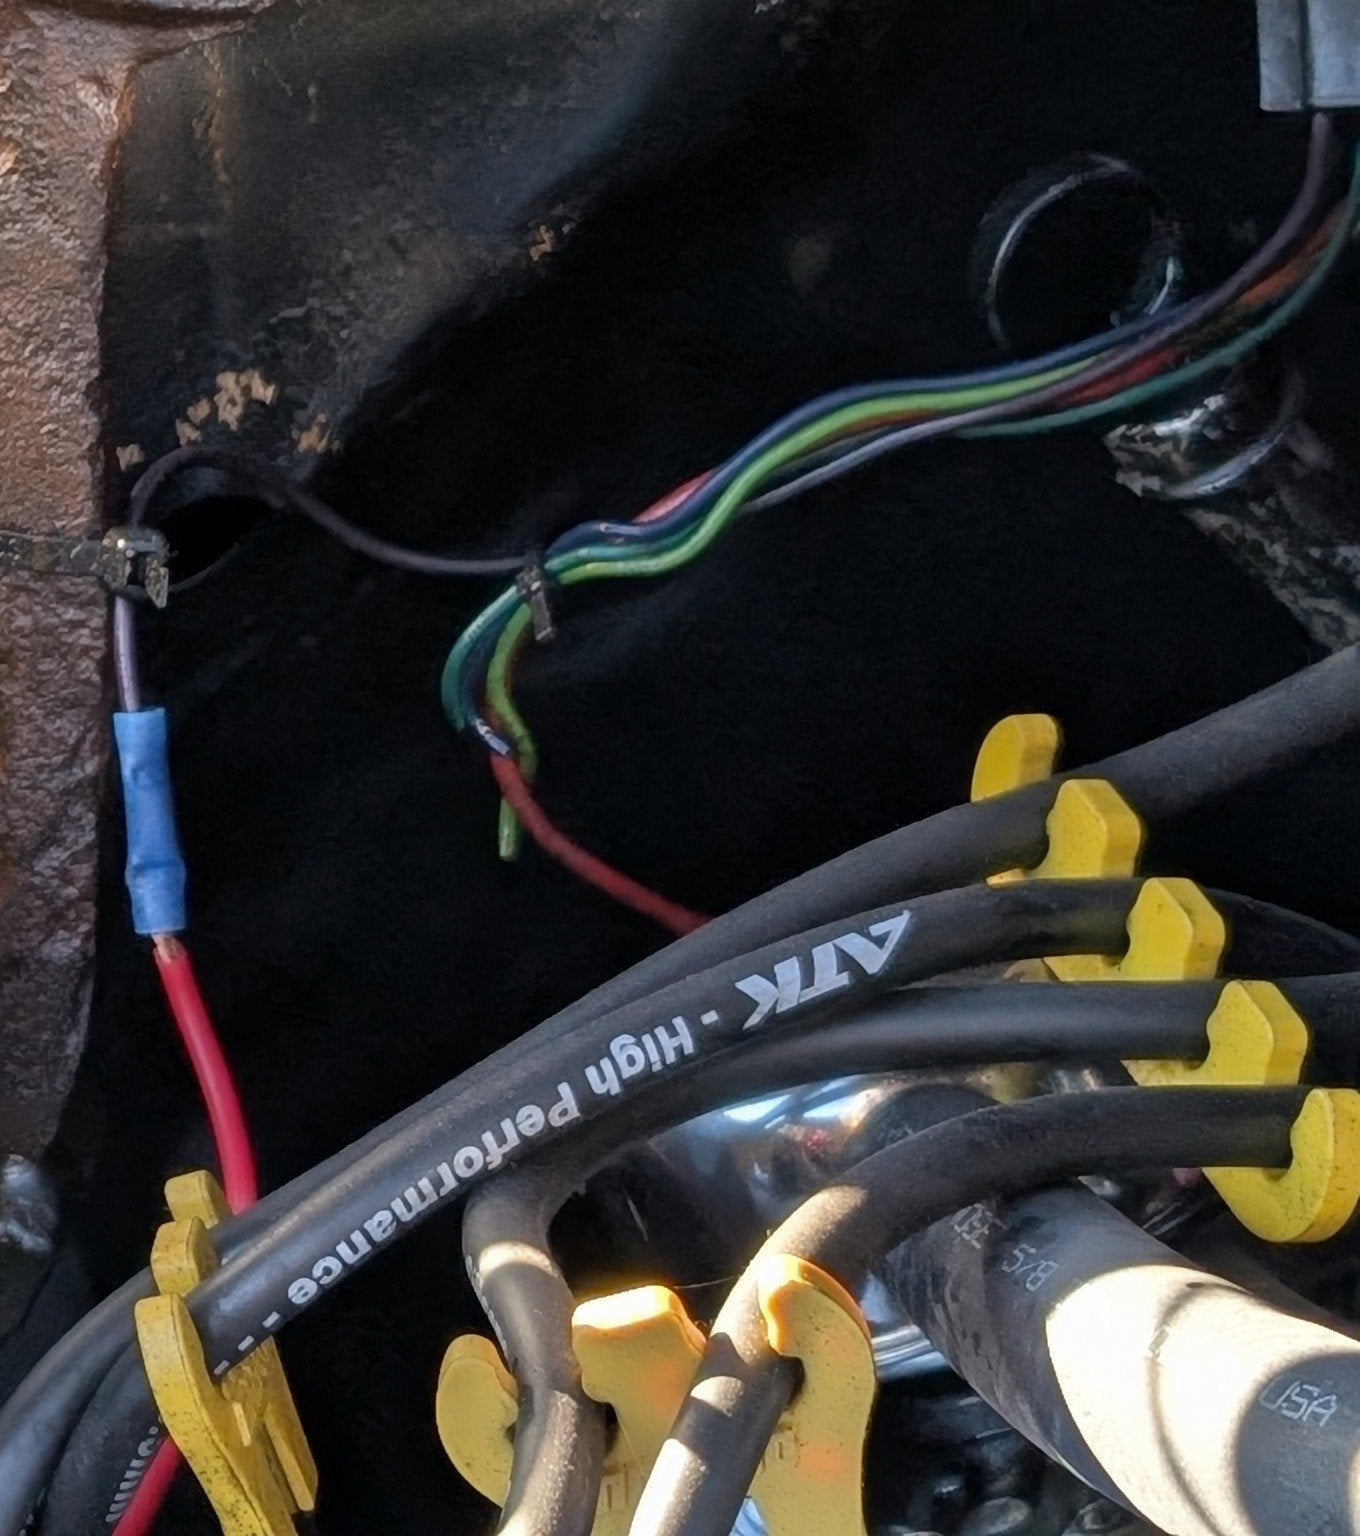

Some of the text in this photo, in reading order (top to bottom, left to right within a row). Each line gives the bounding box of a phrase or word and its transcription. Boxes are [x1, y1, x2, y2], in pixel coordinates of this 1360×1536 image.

[585, 1014, 695, 1097] High
[287, 1097, 581, 1309] Performance
[1000, 1244, 1059, 1292] 5/8
[1258, 1377, 1339, 1428] USA
